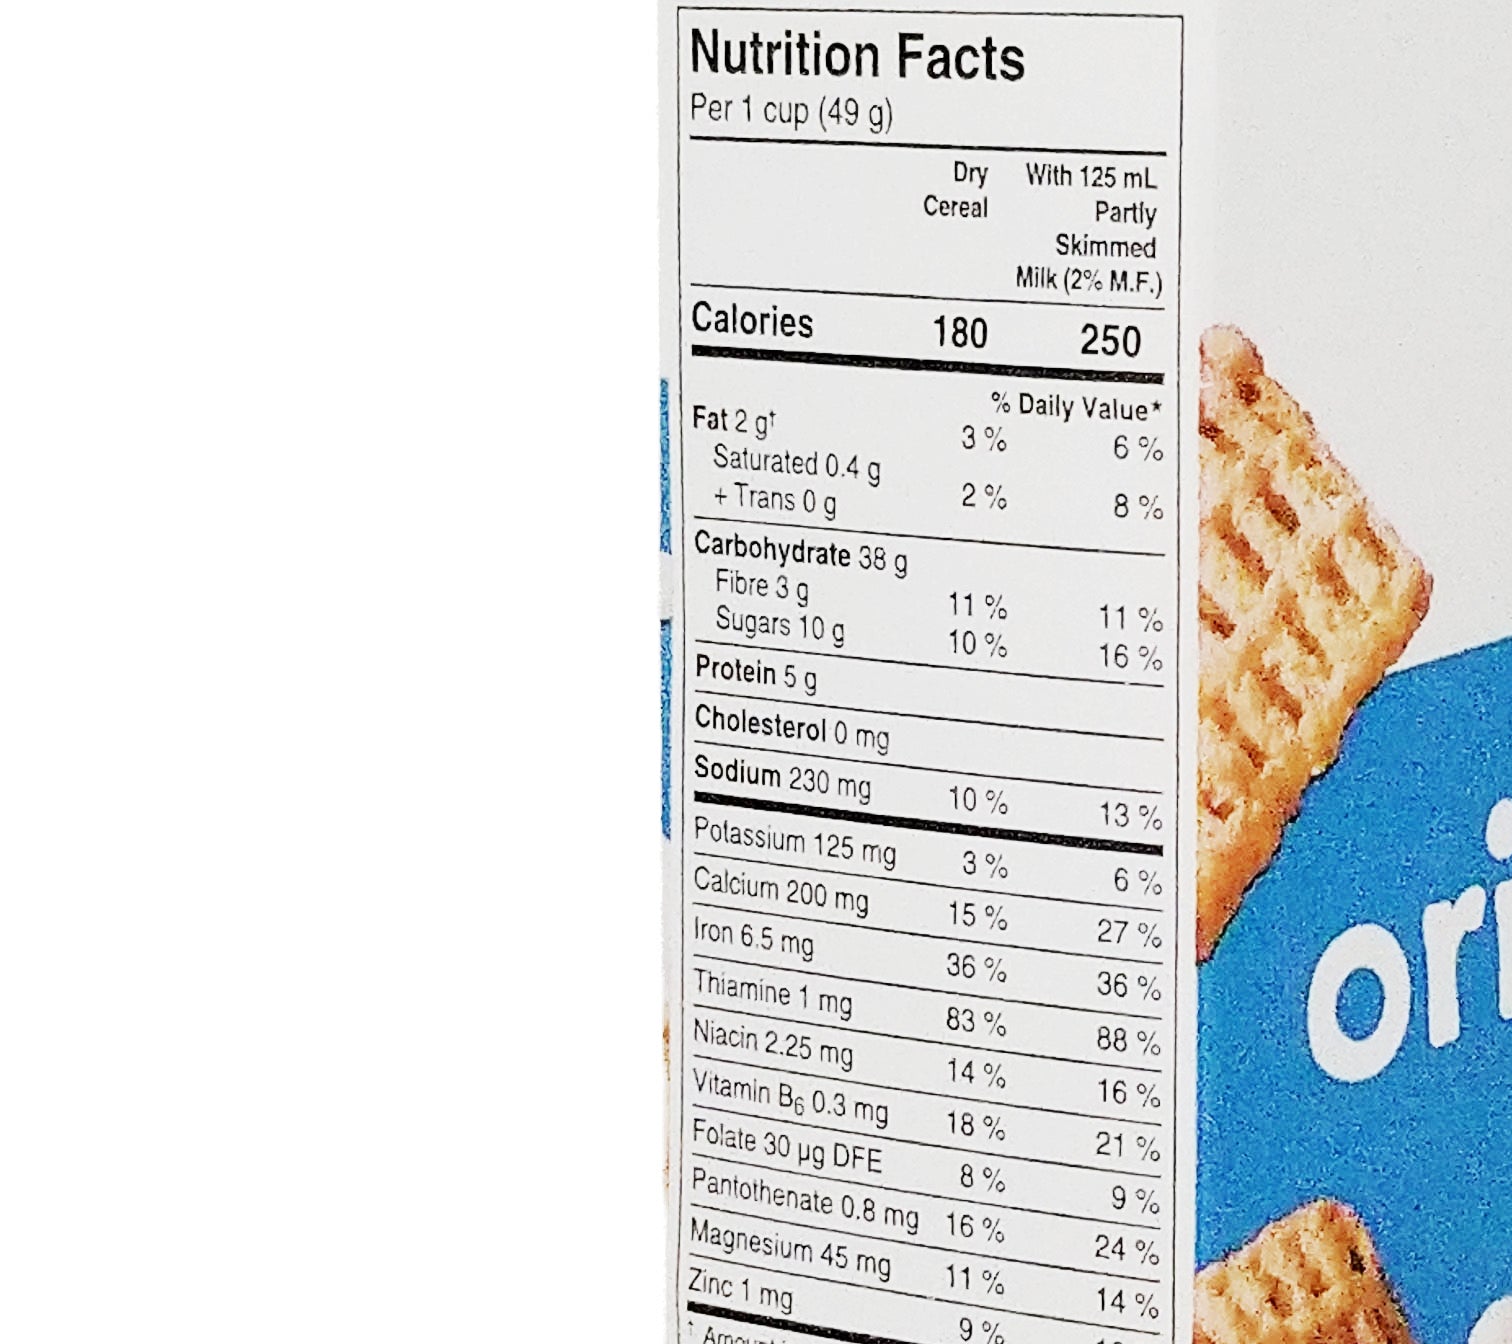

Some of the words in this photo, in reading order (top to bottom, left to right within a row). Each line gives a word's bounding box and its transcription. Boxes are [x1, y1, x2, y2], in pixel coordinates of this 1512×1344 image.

[691, 27, 879, 78] Nutrition
[898, 32, 1025, 82] Facts
[691, 92, 733, 122] Per
[742, 94, 751, 122] 1
[763, 101, 809, 132] cup
[819, 95, 859, 133] (49
[868, 96, 893, 135] g)
[954, 160, 989, 190] Dry
[1025, 162, 1072, 187] With
[1080, 165, 1117, 189] 125
[1123, 166, 1158, 190] mL
[923, 194, 988, 218] Cereal
[1095, 200, 1158, 230] Partly
[1055, 233, 1156, 259] Skimmed
[1016, 265, 1058, 290] Milk
[1063, 266, 1103, 296] (2%
[1109, 269, 1163, 300] M.F.)
[691, 300, 813, 339] Calories
[933, 314, 988, 349] 180
[1080, 322, 1142, 358] 250
[991, 391, 1011, 414] %
[1019, 392, 1075, 423] Daily
[694, 529, 851, 569] Carbohydrate
[858, 545, 886, 571] 38
[894, 553, 908, 580] g
[716, 567, 769, 597] Fibre
[775, 574, 789, 599] 3
[796, 582, 809, 608] g
[716, 604, 791, 640] Sugars
[799, 615, 825, 641] 10
[832, 623, 845, 649] g
[696, 653, 776, 685] Protein
[784, 664, 797, 688] 5
[804, 671, 817, 697] g
[695, 703, 826, 743] Cholesterol
[834, 720, 848, 745] 0
[856, 728, 890, 757] mg
[694, 753, 781, 788] Sodium
[789, 766, 830, 794] 230
[838, 777, 871, 806] mg
[694, 815, 805, 853] Potassium
[814, 832, 854, 860] 125
[862, 843, 897, 872] mg
[694, 865, 779, 900] Calcium
[786, 879, 827, 908] 200
[835, 891, 869, 920] mg
[694, 1017, 758, 1051] Niacin
[765, 1030, 812, 1060] 2.25
[820, 1044, 853, 1073] mg
